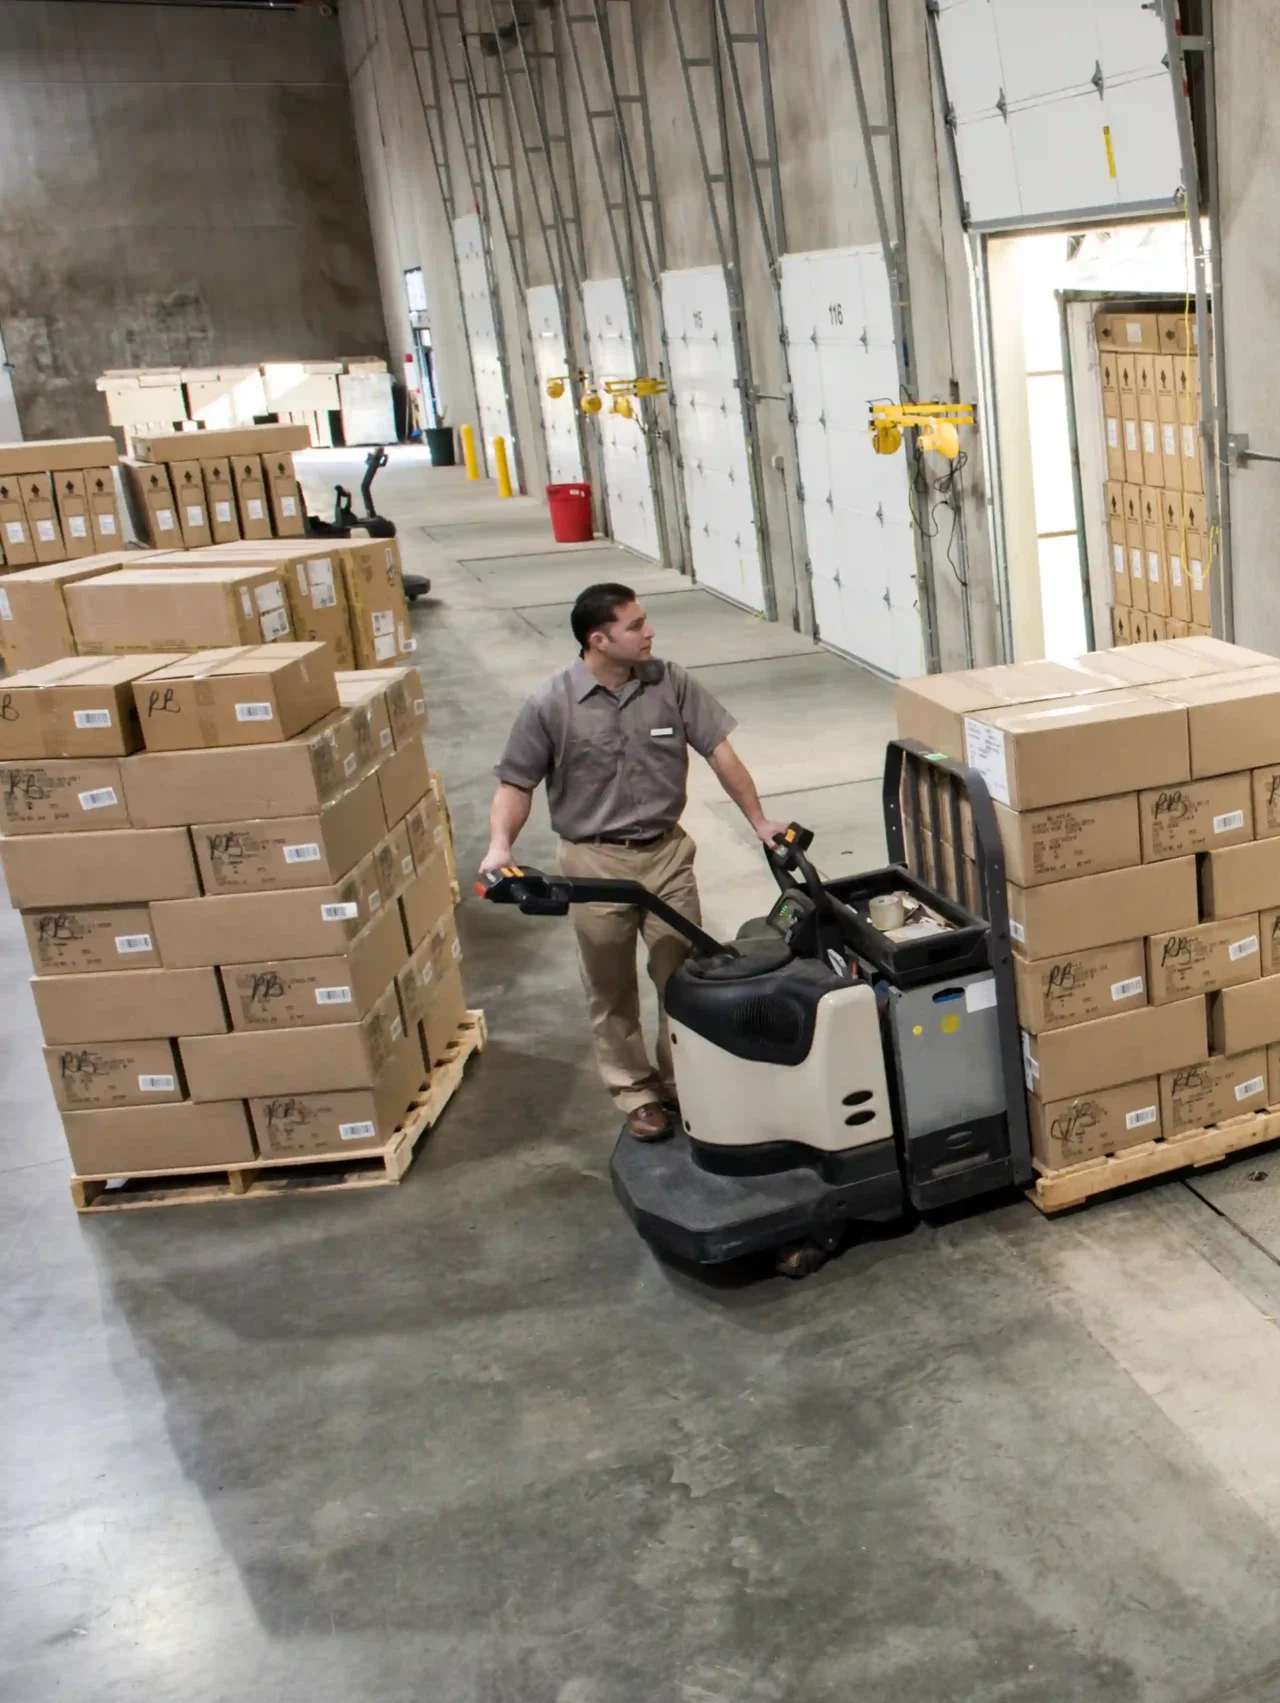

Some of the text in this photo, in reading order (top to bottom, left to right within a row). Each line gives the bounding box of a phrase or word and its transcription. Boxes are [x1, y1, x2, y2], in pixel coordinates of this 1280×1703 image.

[829, 303, 844, 326] 116
[148, 688, 181, 718] RB
[10, 771, 46, 800] RB
